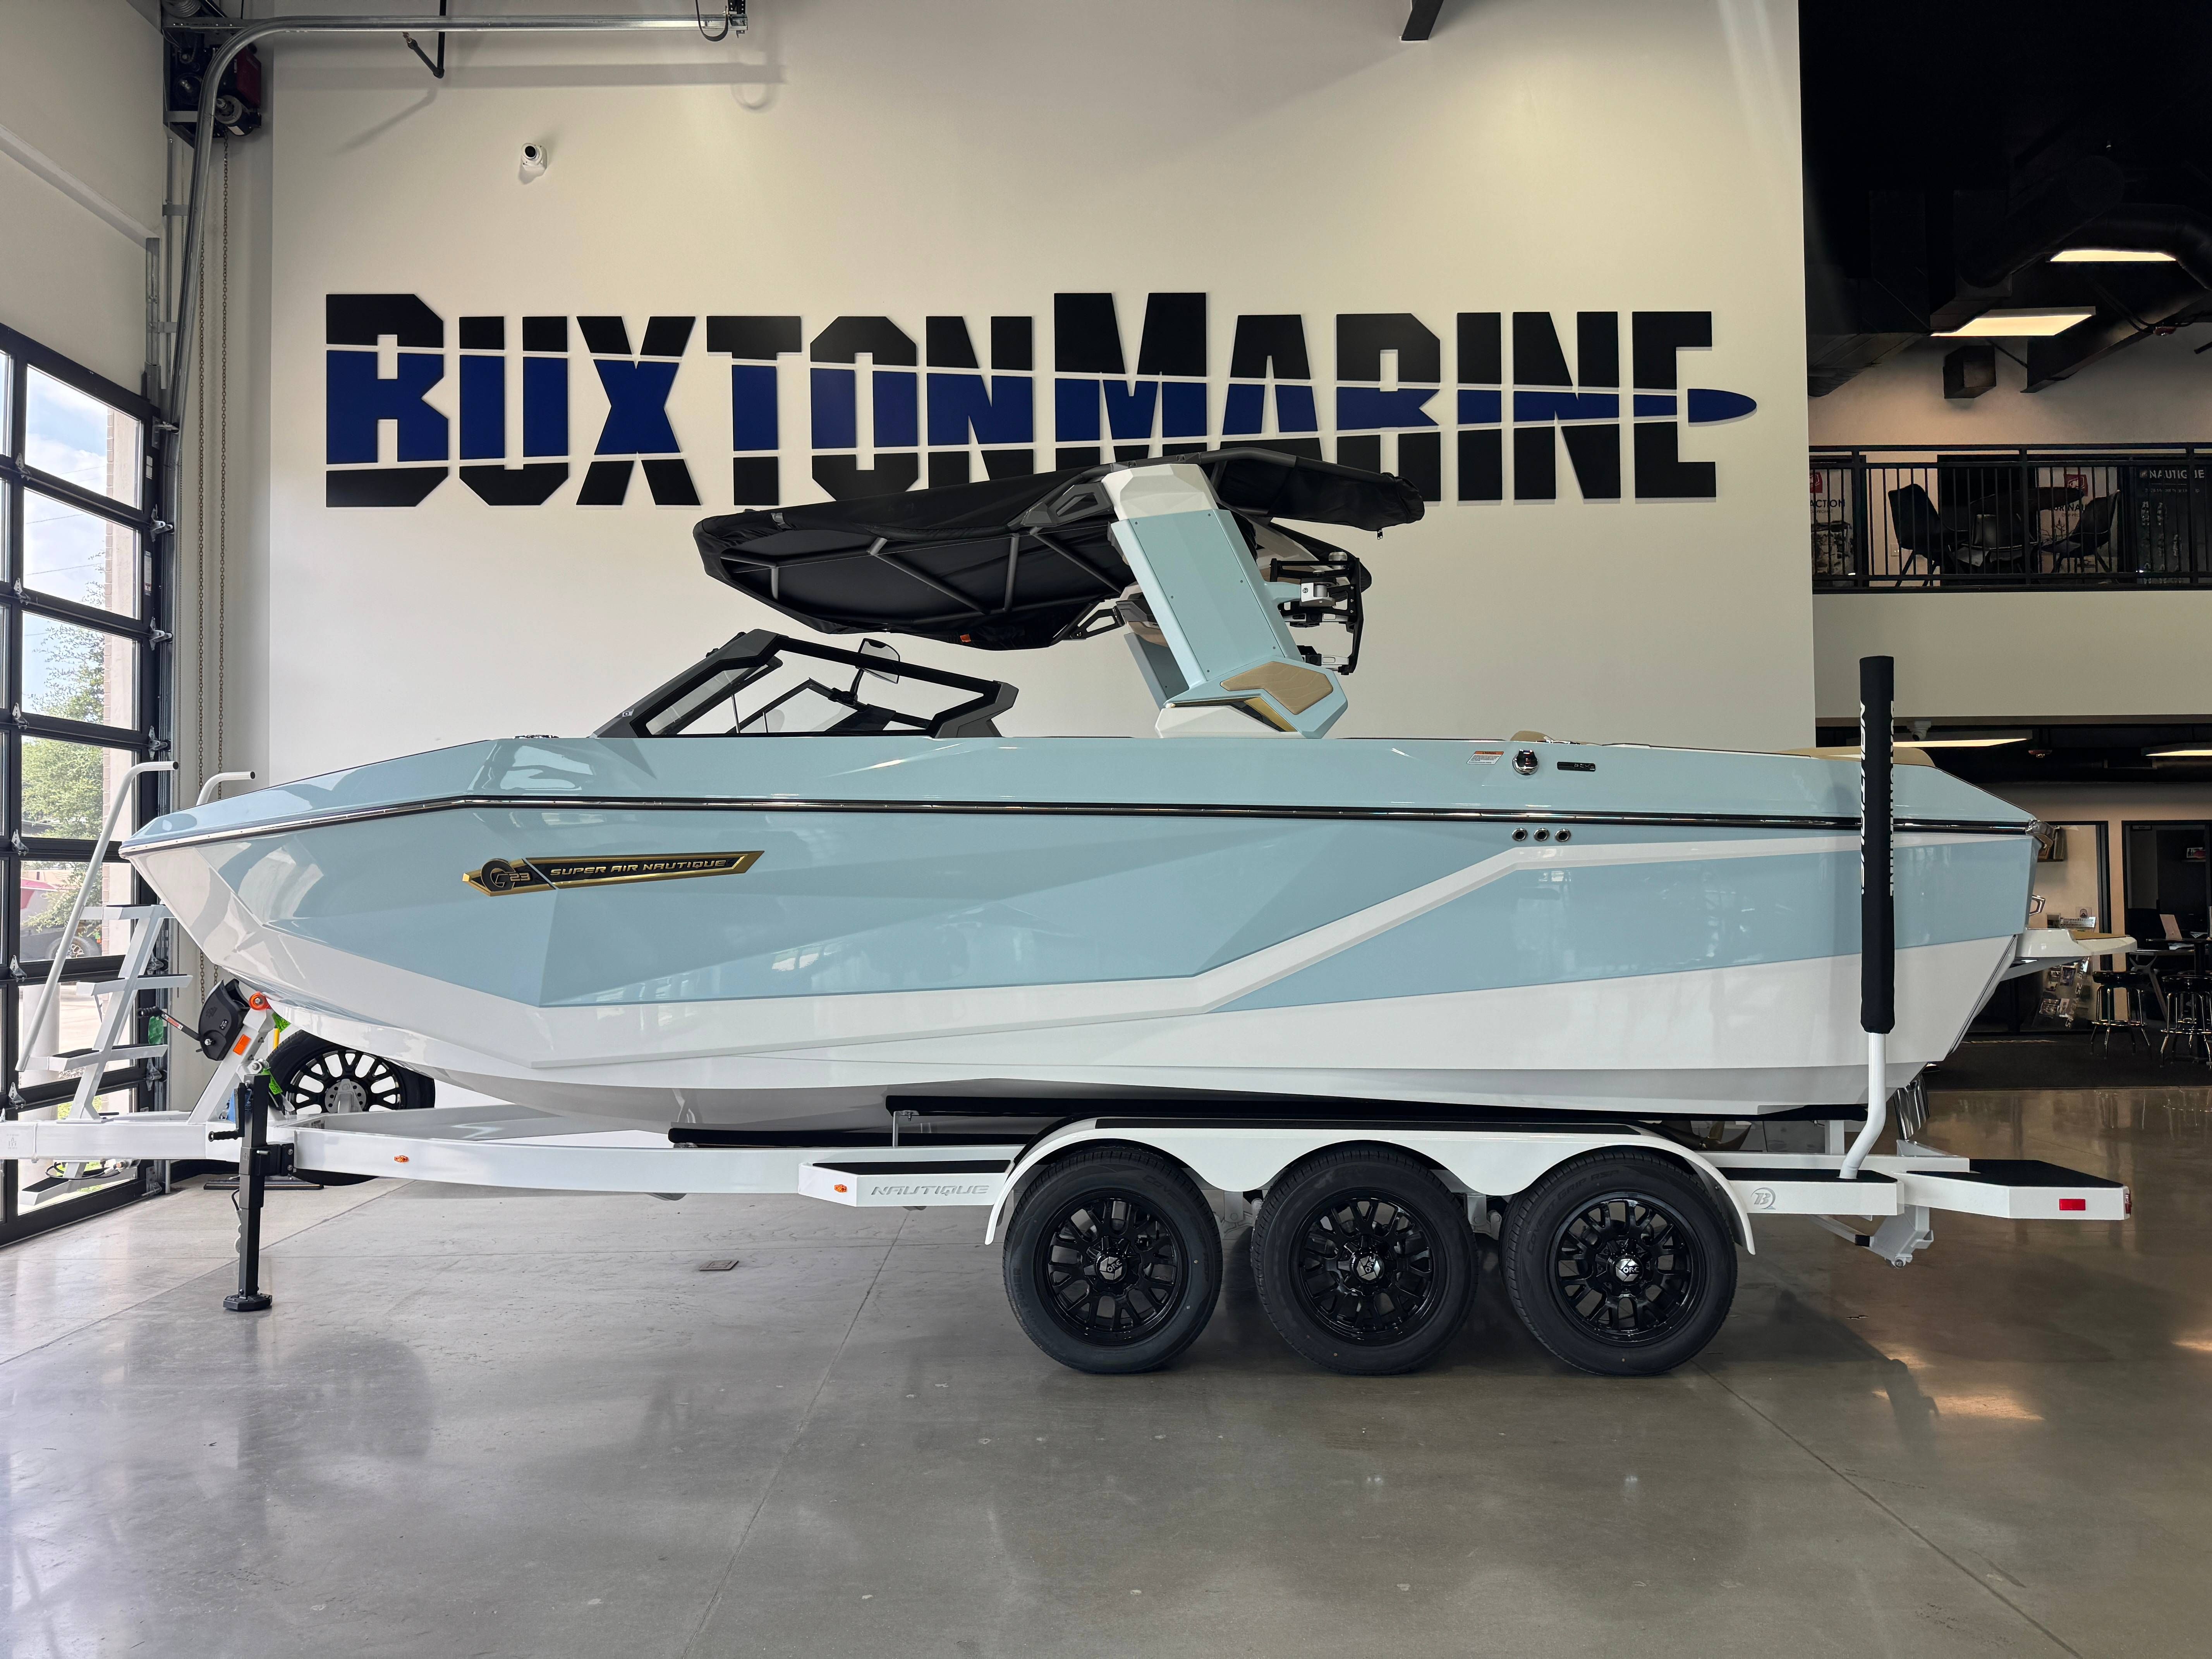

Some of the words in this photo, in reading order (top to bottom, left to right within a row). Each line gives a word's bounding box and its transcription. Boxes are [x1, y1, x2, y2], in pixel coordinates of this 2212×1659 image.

[1810, 499, 1845, 508] ACTON
[550, 866, 606, 876] SUPER
[611, 864, 639, 872] AIR
[643, 859, 726, 871] NAUTIQUE
[871, 1185, 990, 1196] NAUTIQUE
